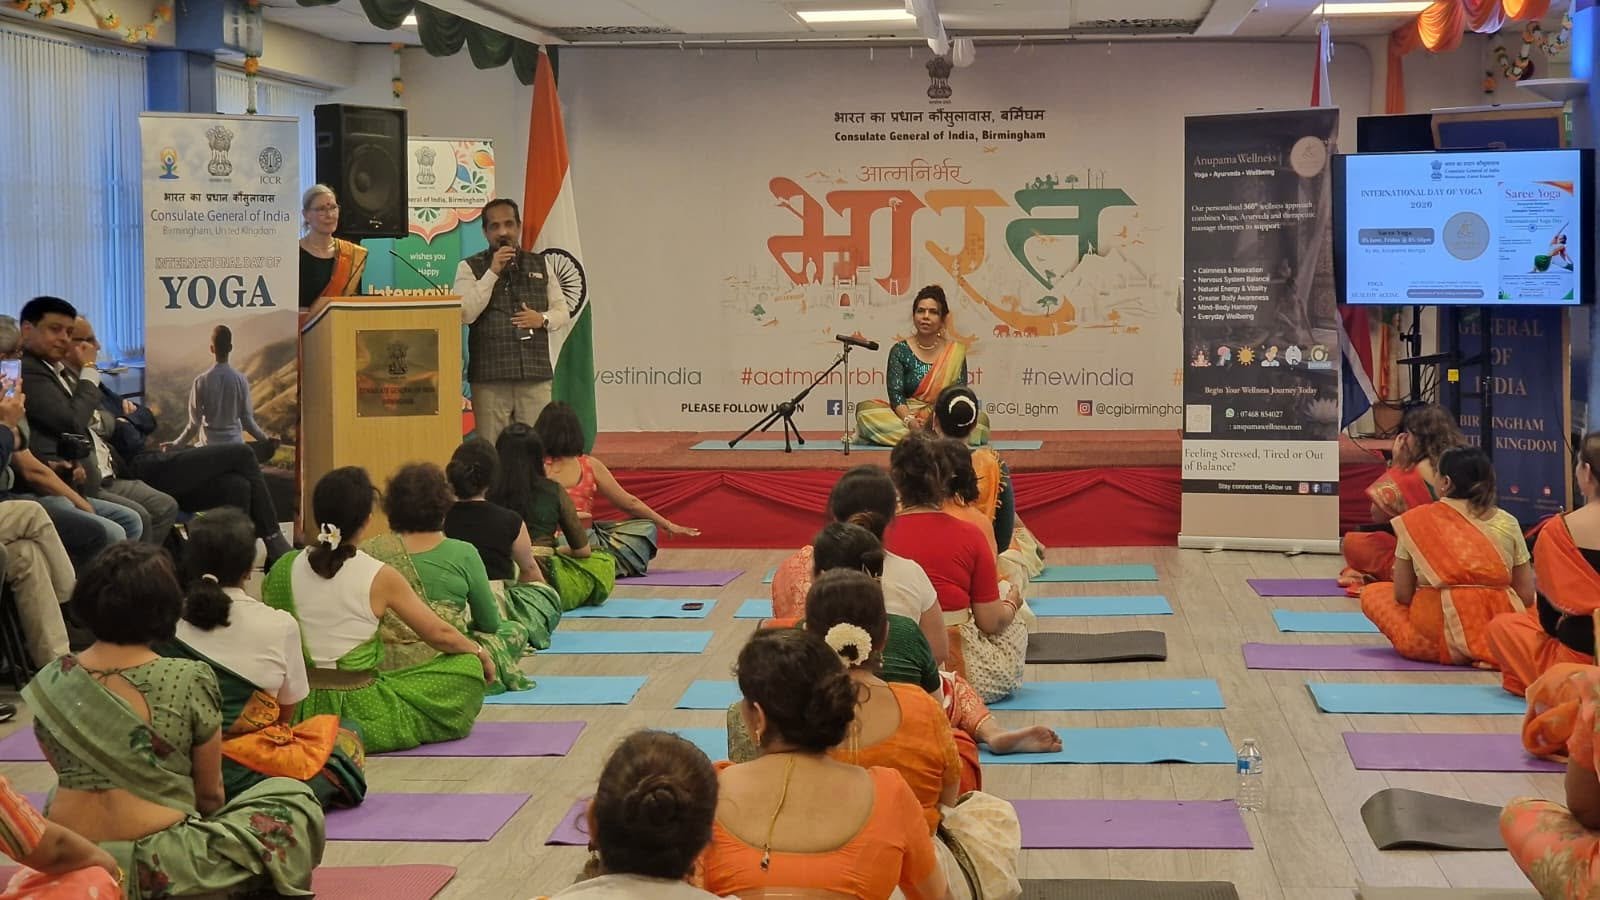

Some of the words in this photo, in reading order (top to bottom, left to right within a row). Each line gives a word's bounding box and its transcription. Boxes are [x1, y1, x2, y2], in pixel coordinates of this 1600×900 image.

[834, 110, 865, 123] भारत
[870, 110, 885, 123] का
[891, 110, 924, 123] प्रधान
[834, 130, 886, 141] Consulate
[890, 130, 929, 141] General
[933, 130, 944, 141] of
[948, 130, 978, 143] India,
[982, 130, 1046, 143] Birmingham
[856, 158, 972, 185] आत्मनिर्भर
[1194, 171, 1208, 179] Yoga
[1213, 170, 1240, 178] Ayurveda
[1246, 169, 1275, 177] Wellbeing
[260, 175, 282, 185] ICCR
[164, 192, 185, 202] भारत
[190, 192, 201, 202] का
[1361, 189, 1427, 198] INTERNATIONAL
[1428, 188, 1445, 196] DAY
[1446, 188, 1457, 196] OF
[1505, 189, 1534, 199] Saree
[1538, 188, 1561, 200] Yoga
[448, 195, 486, 205] Birmingham
[1285, 201, 1313, 211] approach
[151, 208, 206, 222] Consulate
[207, 208, 247, 222] General
[249, 208, 261, 222] of
[263, 209, 291, 222] India
[1192, 214, 1220, 222] combines
[1240, 213, 1269, 222] Ayurveda
[242, 226, 277, 237] Kingdom
[1254, 223, 1280, 232] support
[410, 252, 433, 260] wishes
[434, 253, 446, 261] you
[418, 268, 439, 277] Happy
[1224, 276, 1246, 284] System
[159, 275, 276, 309] YOGA
[368, 284, 454, 297] Internati
[1246, 285, 1267, 293] Vitality
[1198, 304, 1230, 312] Mind-Body
[1231, 304, 1258, 312] Harmony
[1226, 313, 1255, 321] Wellbeing
[1459, 318, 1544, 336] GEERAL
[1022, 367, 1134, 386] #newindia
[1475, 375, 1527, 396] IDIA
[1204, 386, 1223, 396] Begin
[1224, 386, 1240, 395] Your
[1241, 386, 1270, 394] Wellness
[1270, 386, 1296, 396] Journey
[1297, 386, 1317, 396] Today
[681, 403, 721, 413] PLEASE
[723, 403, 769, 413] FOLLOW
[986, 402, 1059, 417] @CGI_Bghm
[1460, 415, 1544, 431] BIRINGHAM
[1495, 436, 1557, 453] KINGDOM
[1184, 447, 1218, 461] Feeling
[1220, 448, 1261, 460] Stressed,
[1263, 448, 1289, 459] Tired
[1292, 451, 1302, 460] or
[1305, 449, 1324, 460] Out
[1184, 460, 1193, 471] of
[1196, 460, 1236, 472] Balance?
[1218, 482, 1231, 491] Stay
[1264, 483, 1283, 491] Follow
